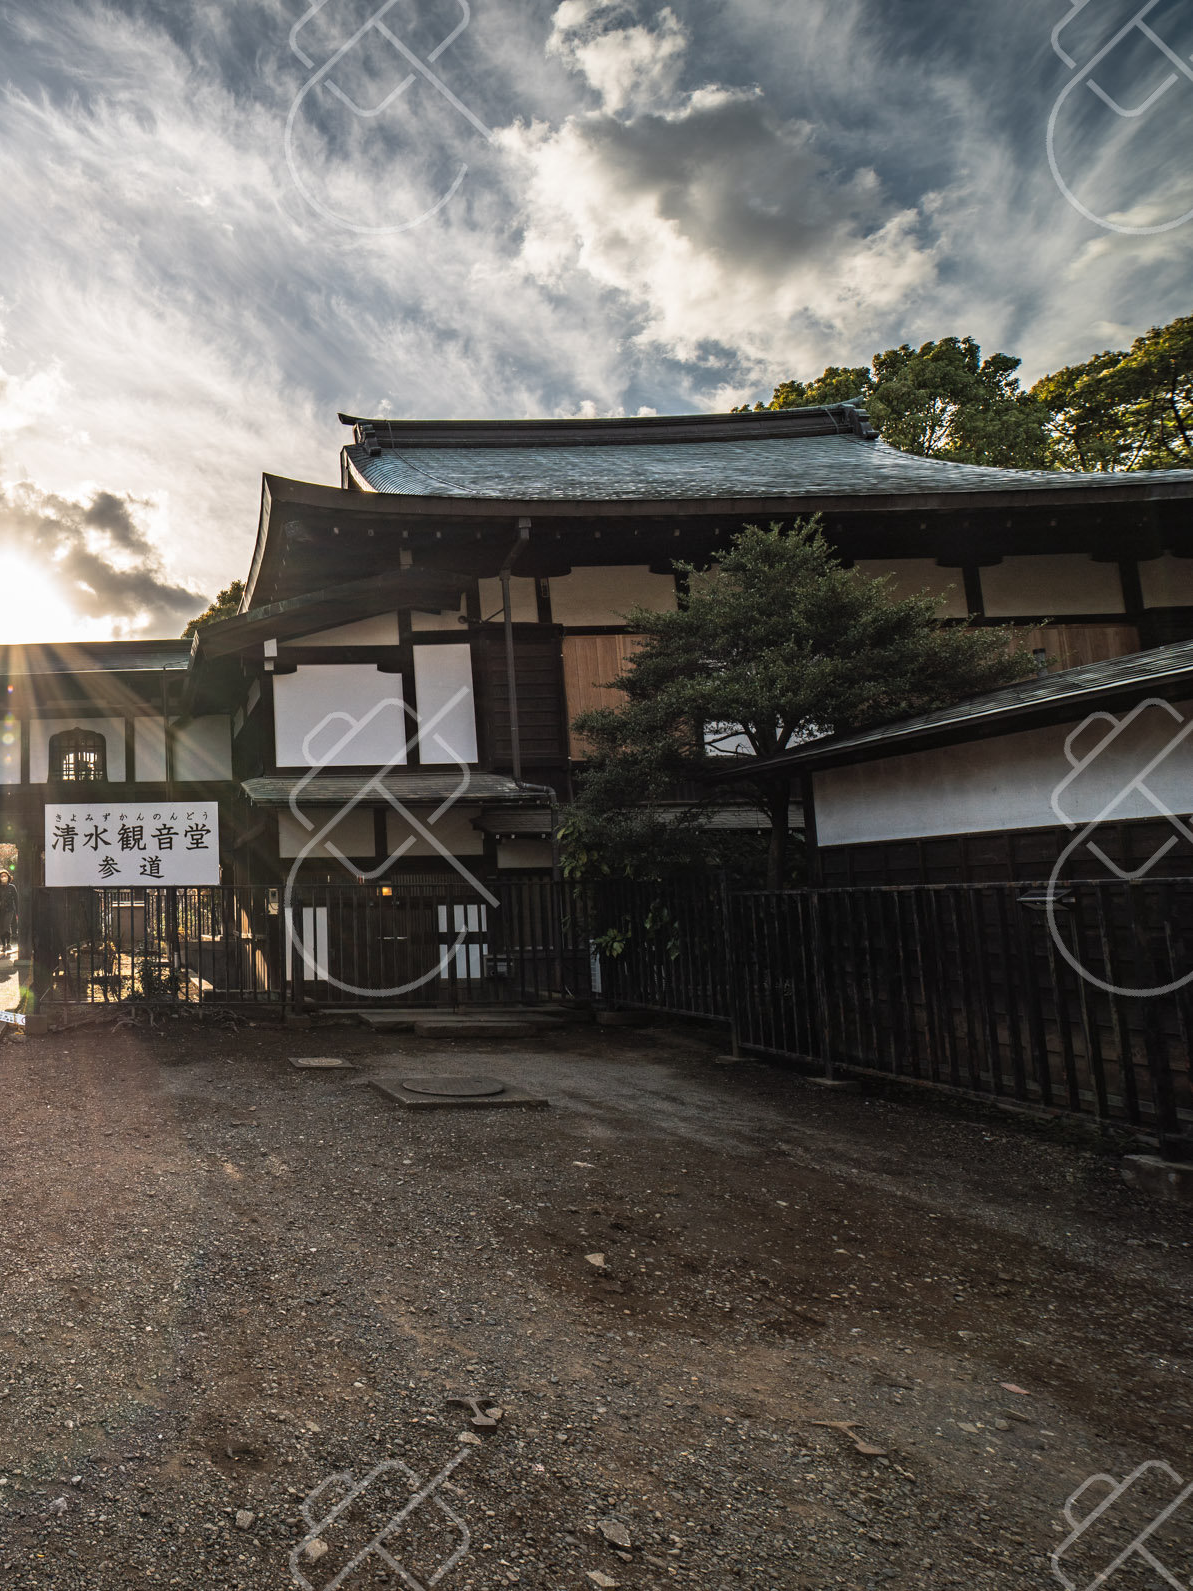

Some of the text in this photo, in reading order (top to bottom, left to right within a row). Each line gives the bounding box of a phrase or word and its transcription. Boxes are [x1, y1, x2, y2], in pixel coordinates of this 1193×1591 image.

[55, 811, 208, 823] きよみずかんのんどう
[51, 822, 212, 854] 清水観音堂
[98, 855, 165, 880] 参道
